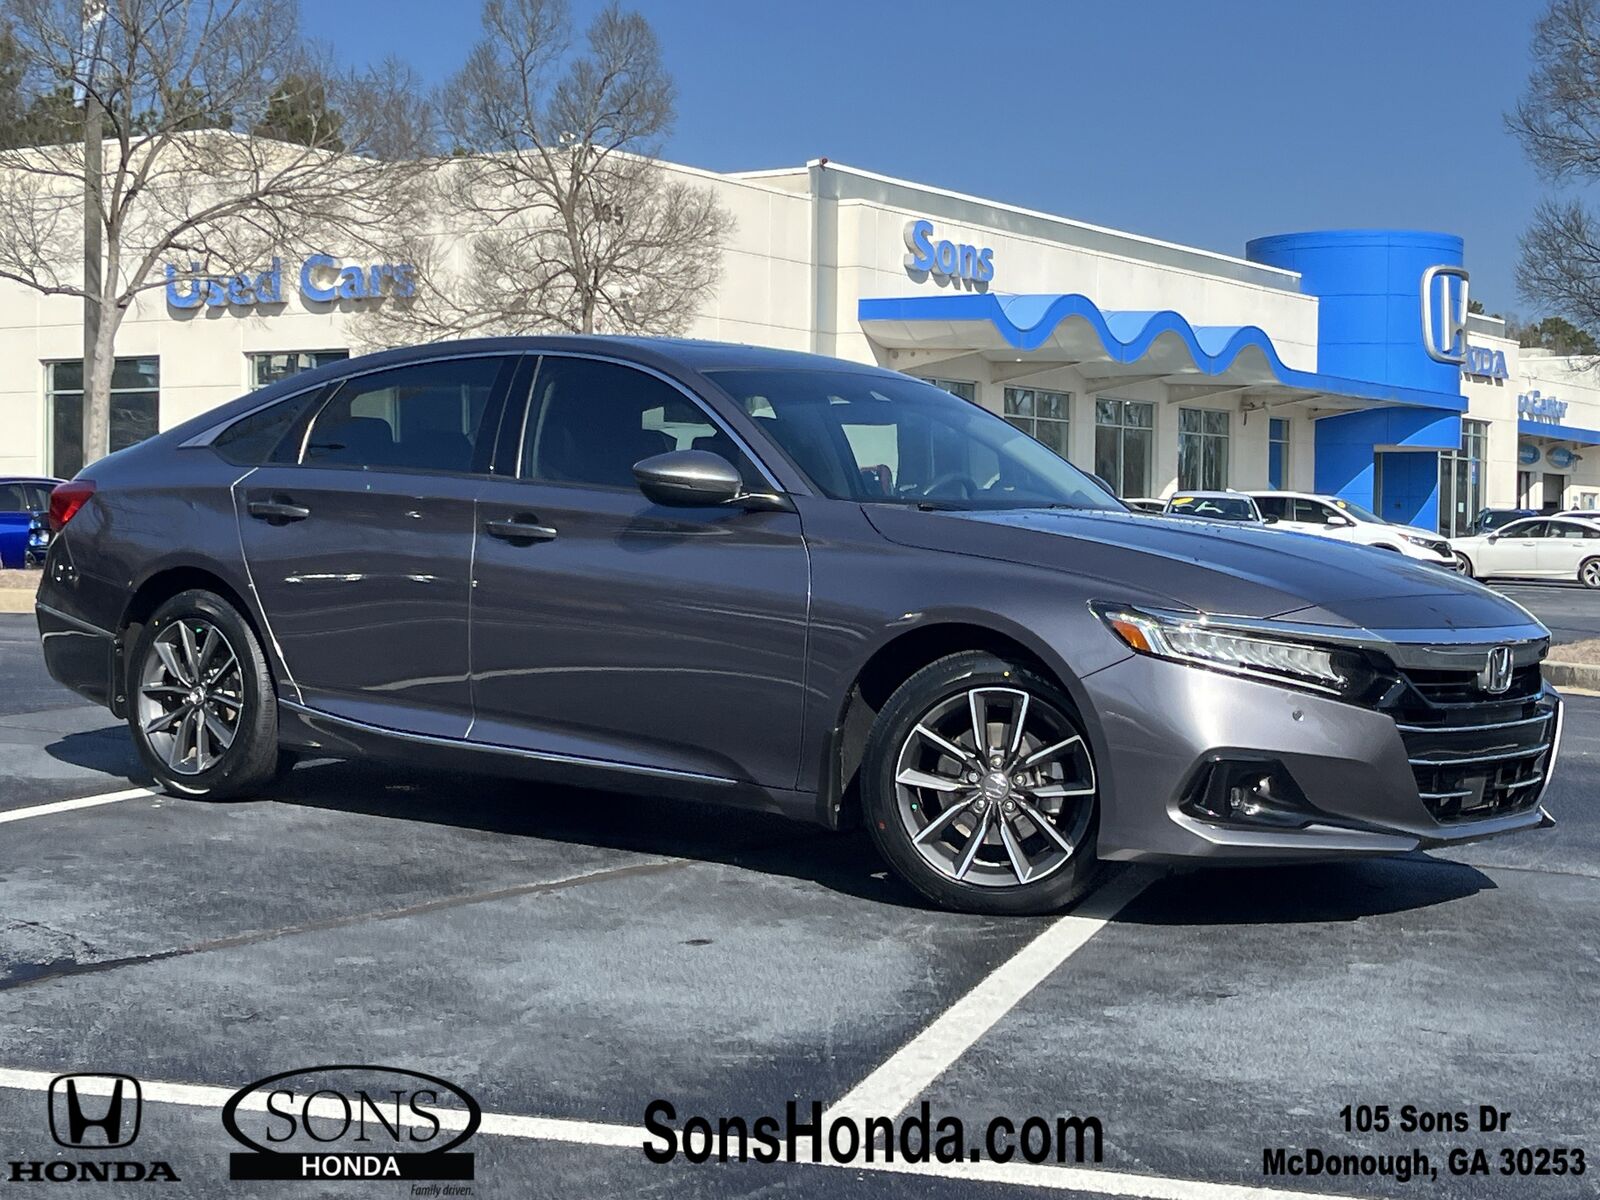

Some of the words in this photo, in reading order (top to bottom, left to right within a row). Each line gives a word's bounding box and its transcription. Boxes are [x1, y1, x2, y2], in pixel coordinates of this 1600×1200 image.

[911, 219, 995, 282] Sons
[165, 255, 283, 310] Used
[300, 253, 416, 303] Cars
